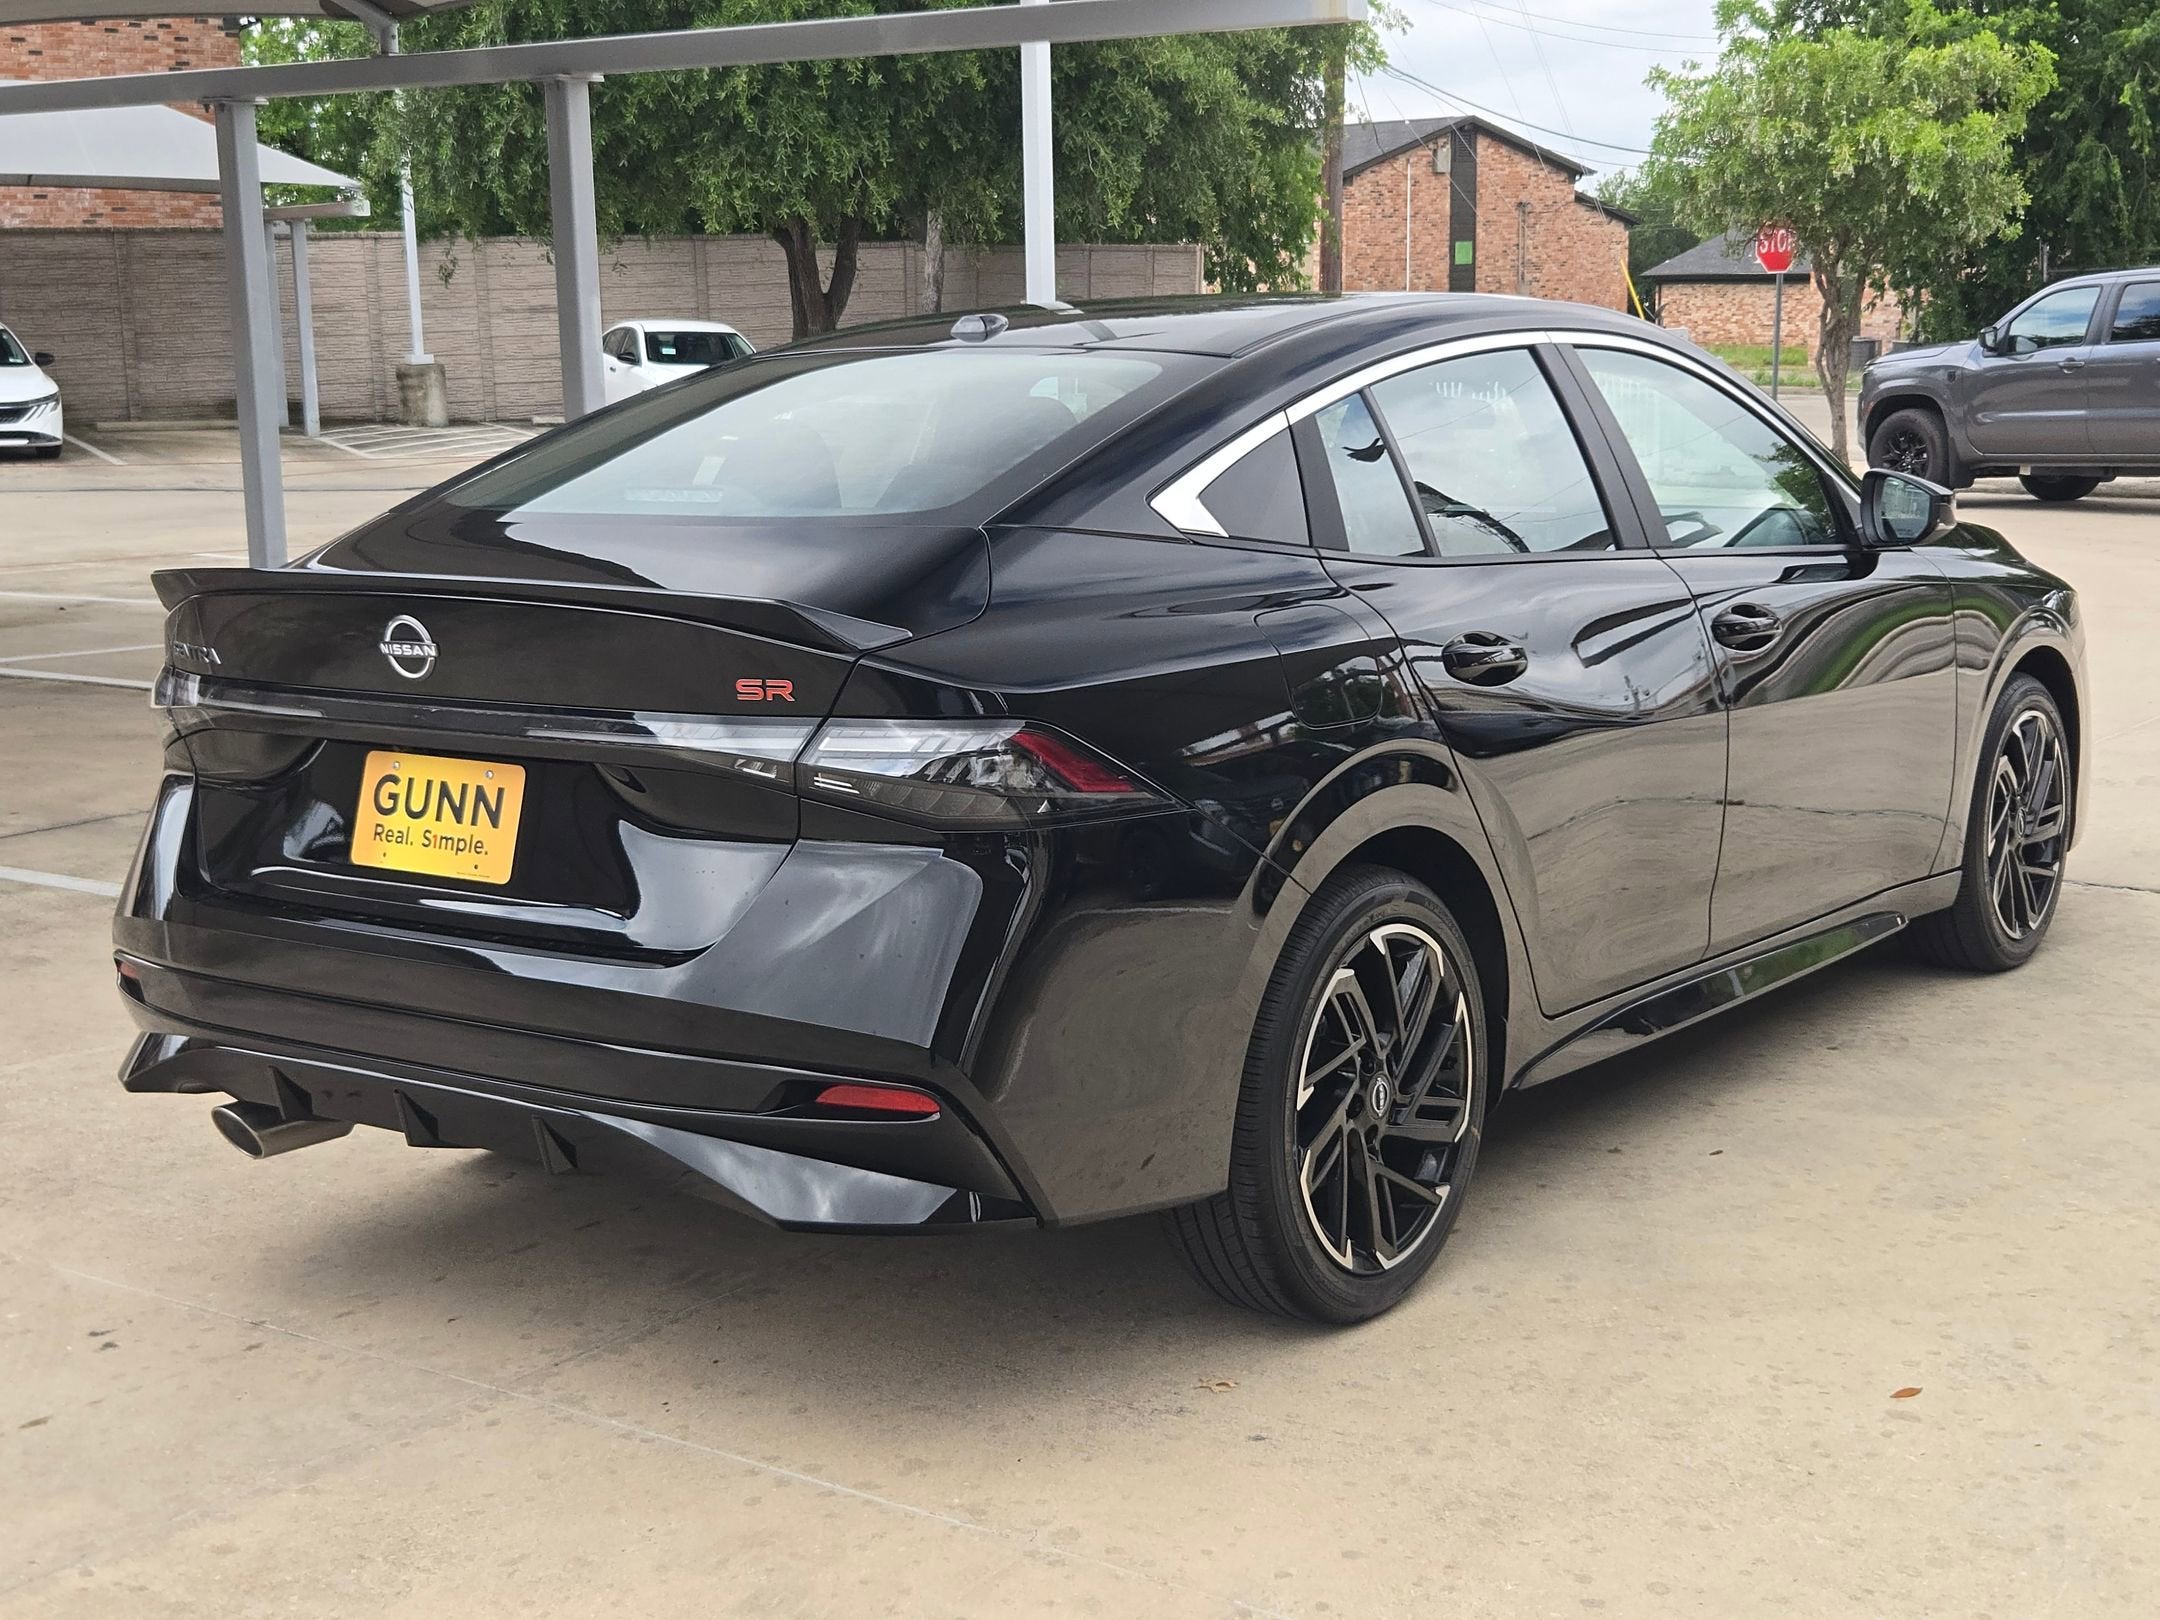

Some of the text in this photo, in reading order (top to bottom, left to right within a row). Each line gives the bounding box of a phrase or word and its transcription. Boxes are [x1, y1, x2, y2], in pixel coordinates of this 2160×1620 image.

[379, 643, 436, 657] NISSAN
[735, 679, 796, 702] SR
[373, 773, 506, 829] GUNN
[373, 823, 413, 846] Real.
